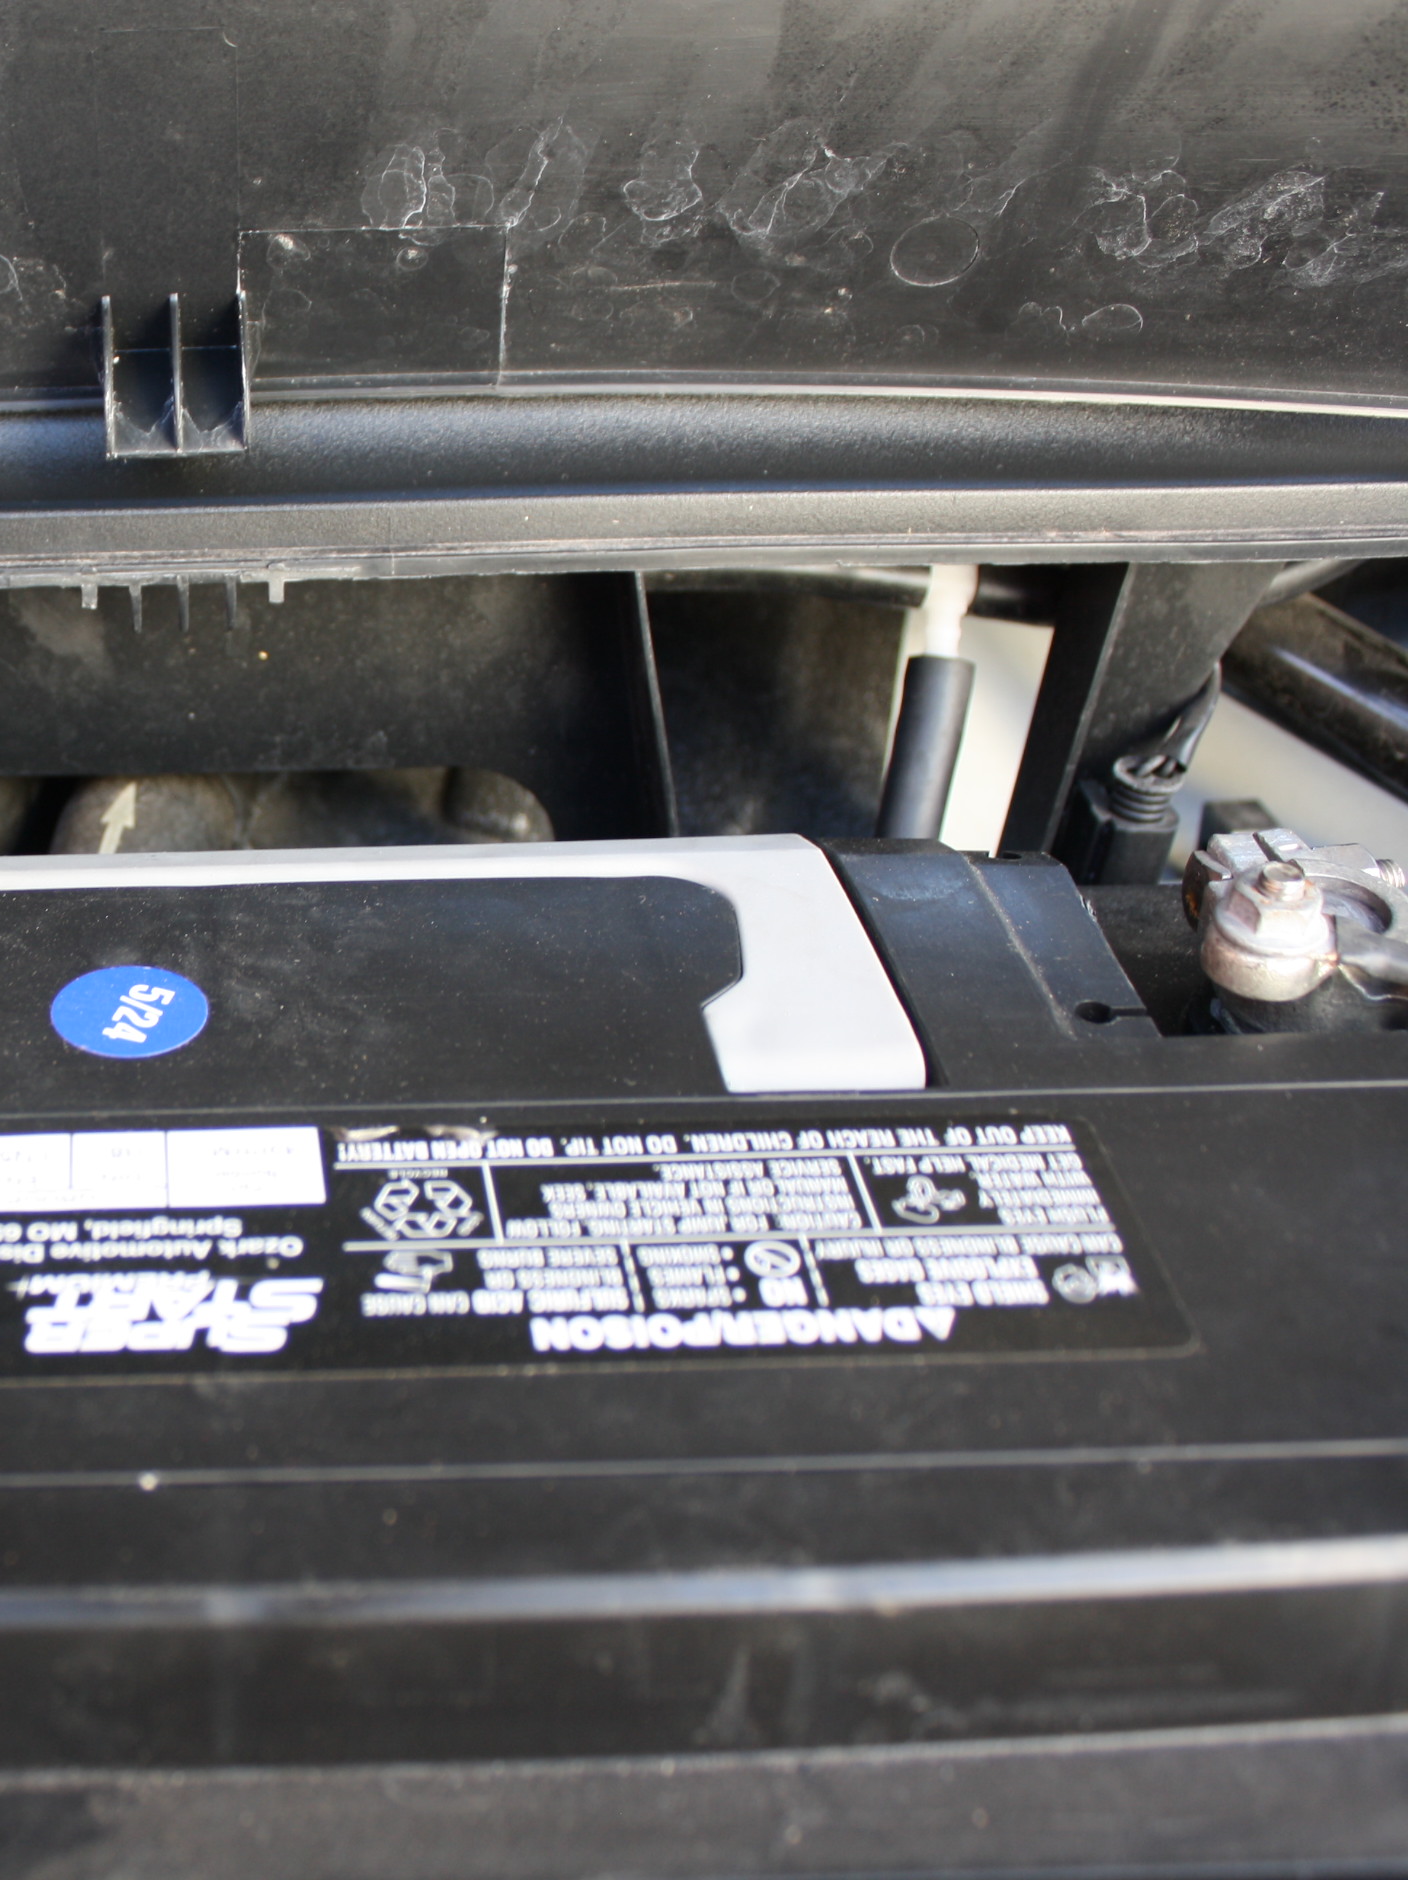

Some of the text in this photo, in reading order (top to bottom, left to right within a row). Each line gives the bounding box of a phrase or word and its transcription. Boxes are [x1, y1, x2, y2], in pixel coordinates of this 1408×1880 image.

[102, 984, 176, 1043] 5/24
[336, 1124, 1073, 1161] KEEP OUT OF THE REACH OF CHILDREN. DO NOT TIP. DO NOT OPEN BATTERY!
[768, 1158, 841, 1178] SERVICE
[918, 1156, 965, 1174] HELP
[542, 1184, 586, 1203] SEEK
[690, 1181, 725, 1199] NOT
[629, 1199, 702, 1217] VEHICLE
[702, 1198, 725, 1216] IN
[27, 1220, 77, 1242] MO
[84, 1215, 243, 1239] Springfield,
[506, 1219, 580, 1238] FOLLOW
[678, 1215, 727, 1234] JUMP
[730, 1214, 768, 1233] FOR
[49, 1239, 213, 1262] Automotive
[218, 1236, 303, 1258] Ozark
[25, 1277, 323, 1324] START
[472, 1289, 523, 1315] ACID
[759, 1276, 809, 1307] NO
[24, 1307, 289, 1354] SUPER
